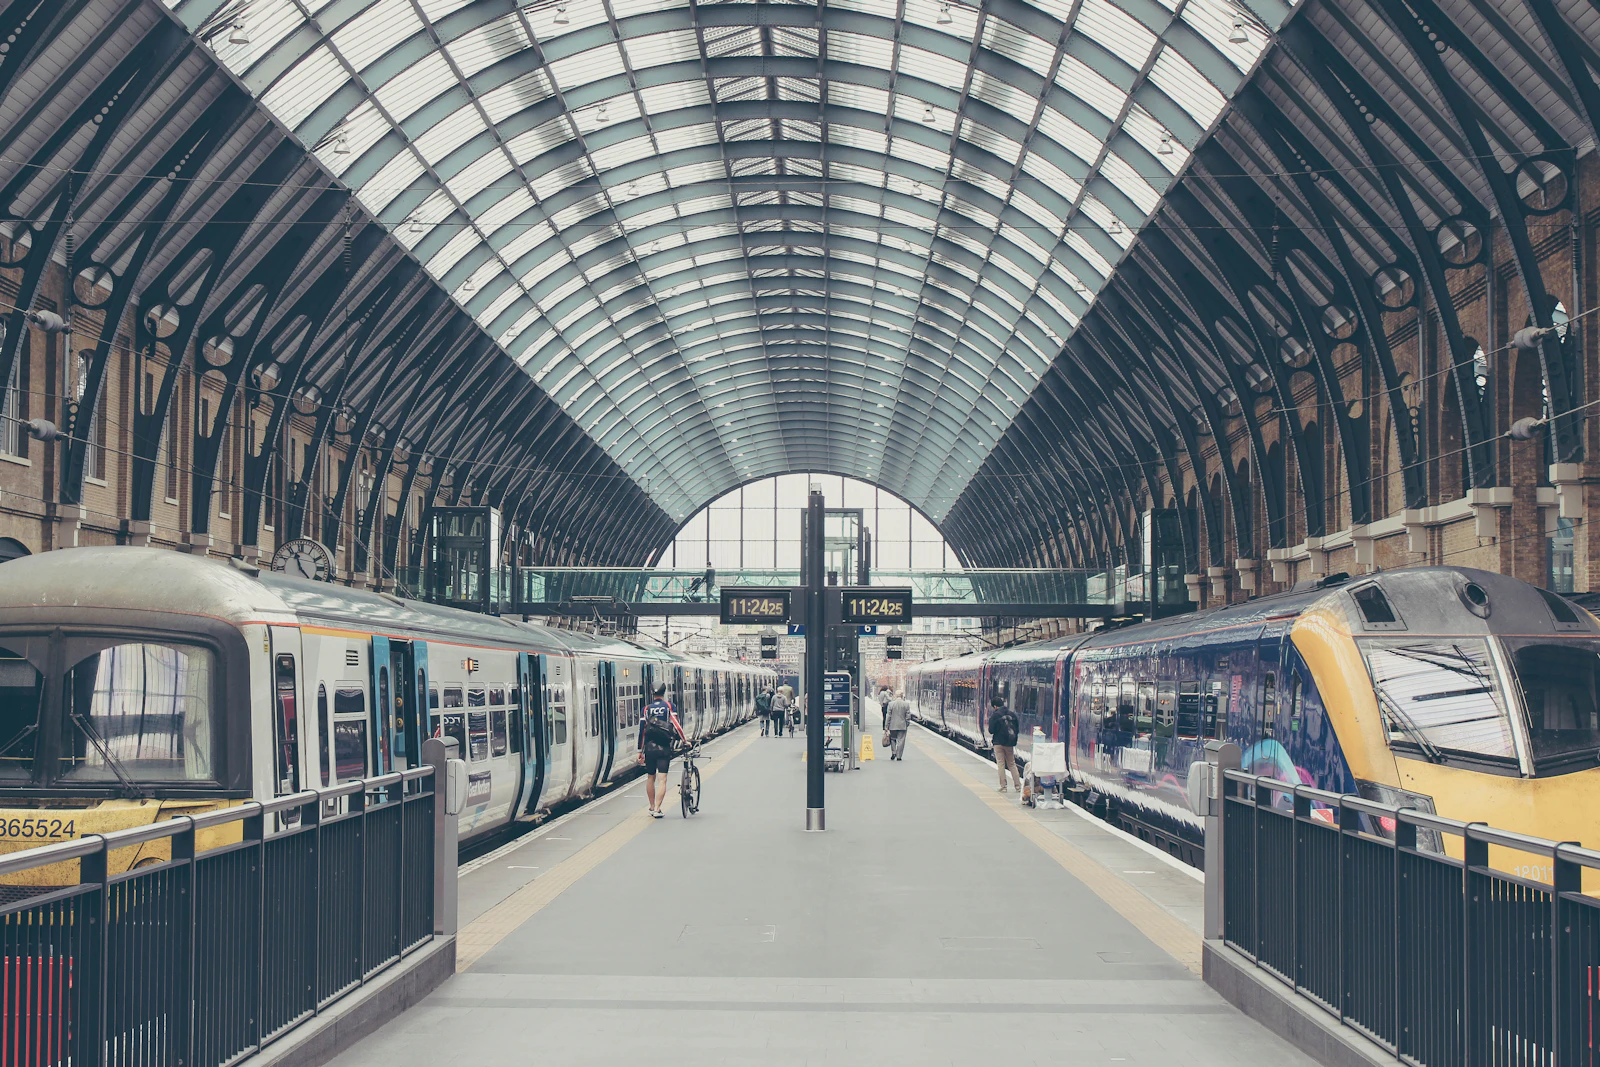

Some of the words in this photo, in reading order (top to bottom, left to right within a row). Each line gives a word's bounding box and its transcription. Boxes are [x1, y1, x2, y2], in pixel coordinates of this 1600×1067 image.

[792, 624, 800, 633] 7
[864, 624, 872, 633] 6
[650, 706, 666, 715] TCC
